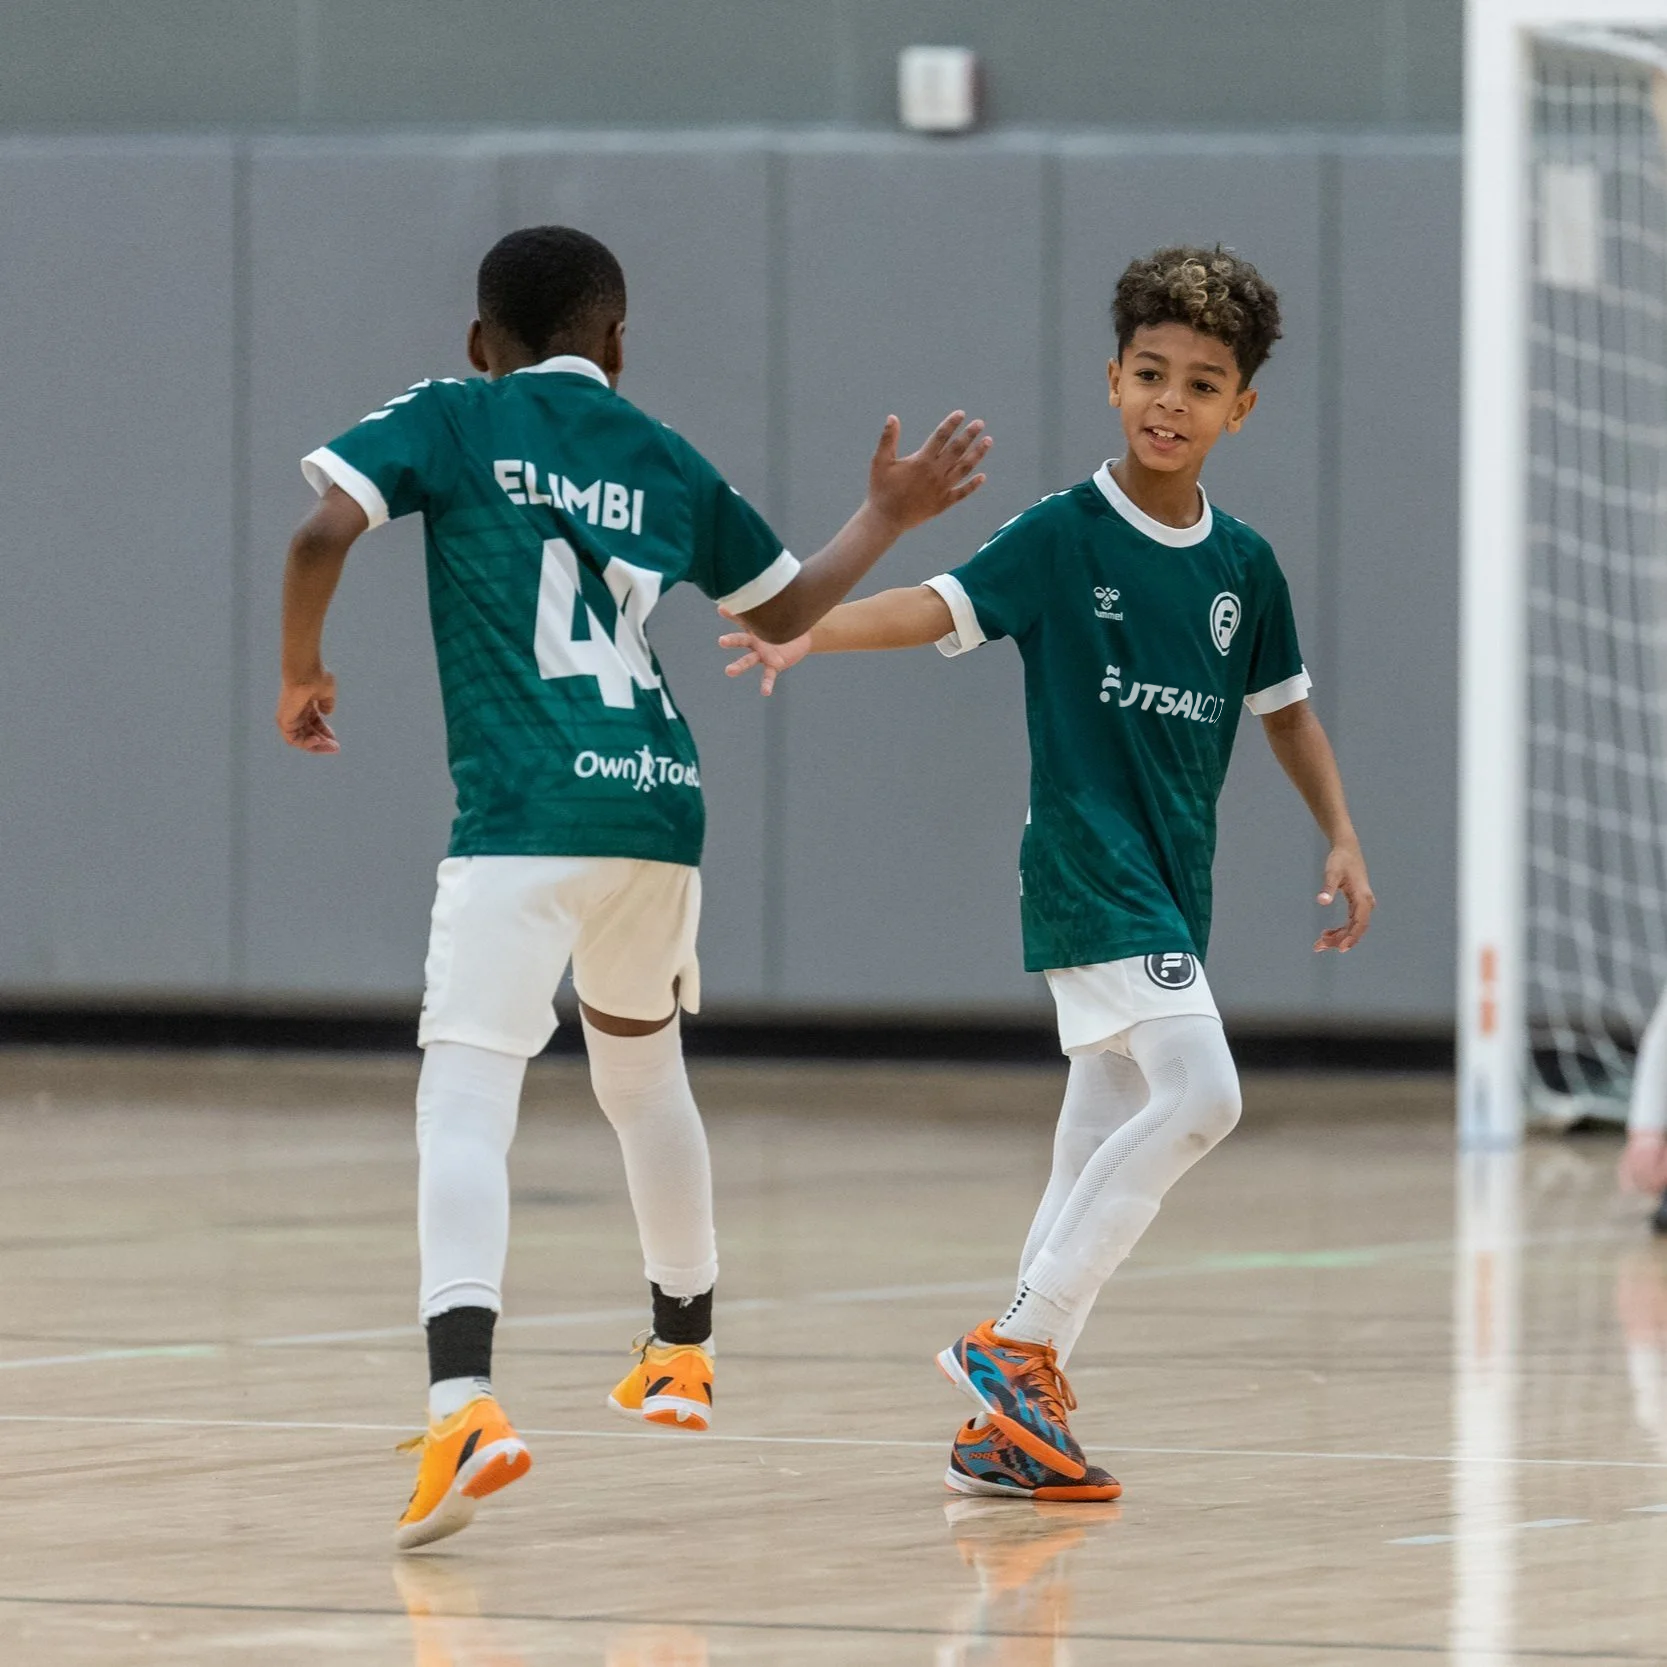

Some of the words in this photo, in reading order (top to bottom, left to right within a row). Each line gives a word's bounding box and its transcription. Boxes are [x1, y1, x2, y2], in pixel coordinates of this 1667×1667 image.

[494, 459, 645, 536] ELIMBI
[533, 537, 678, 720] 44
[574, 750, 637, 780] Own
